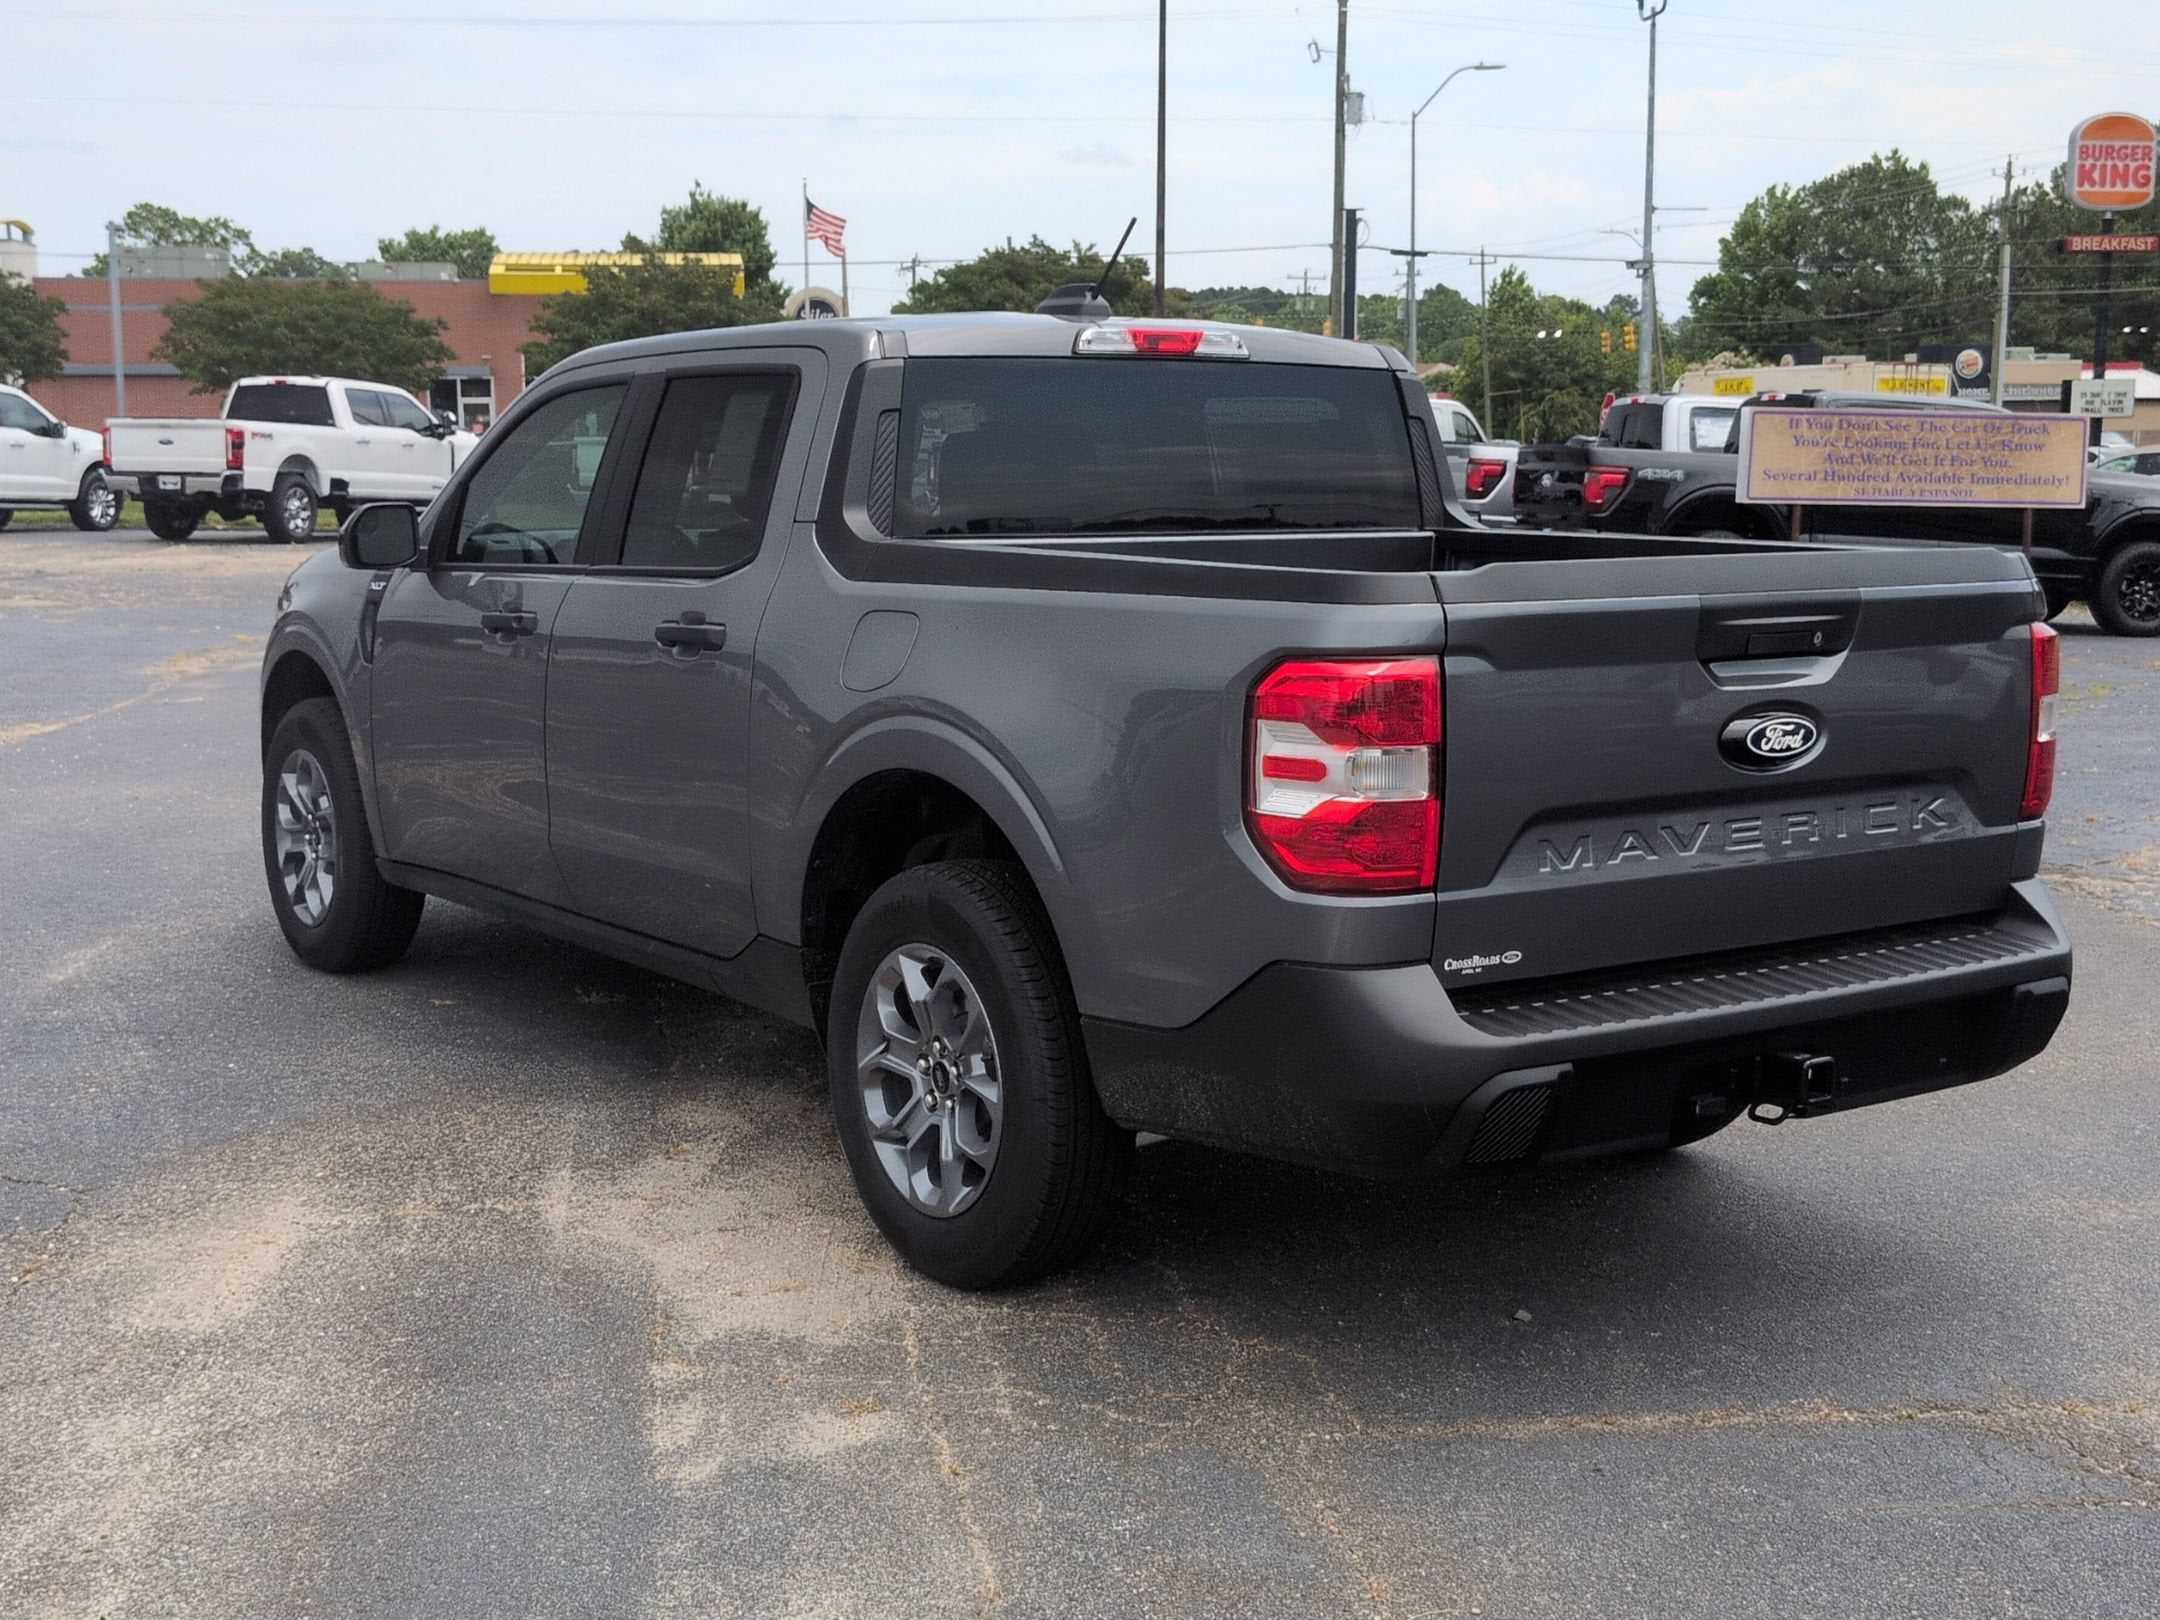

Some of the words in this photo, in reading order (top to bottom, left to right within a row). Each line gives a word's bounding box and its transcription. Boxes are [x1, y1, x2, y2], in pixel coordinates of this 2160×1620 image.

[2078, 144, 2153, 162] BURGER
[2077, 163, 2152, 188] KING
[2072, 237, 2154, 251] BREAKFAST
[1788, 418, 1801, 430] If
[1805, 418, 1833, 430] You
[1838, 418, 1879, 431] Don't
[1884, 420, 1911, 432] See
[1918, 420, 1946, 433] The
[1952, 421, 1979, 434] Car
[1983, 422, 2001, 434] Or
[2011, 422, 2050, 435] Truck
[1792, 435, 1838, 448] You're
[1844, 436, 1906, 450] Looking
[1945, 438, 1970, 450] Let
[1975, 439, 1997, 451] Us
[2001, 439, 2045, 452] Know
[1823, 453, 1855, 465] And
[1857, 453, 1896, 466] We'll
[1900, 454, 1927, 467] Get
[1933, 455, 1946, 467] It
[1950, 455, 1977, 467] For
[1762, 469, 1817, 482] Several
[1823, 469, 1890, 483] Hundred
[1895, 471, 1965, 485] Available
[1969, 472, 2070, 488] Immediately!
[1761, 724, 1805, 751] Ford
[1537, 797, 1949, 873] MAVERICK
